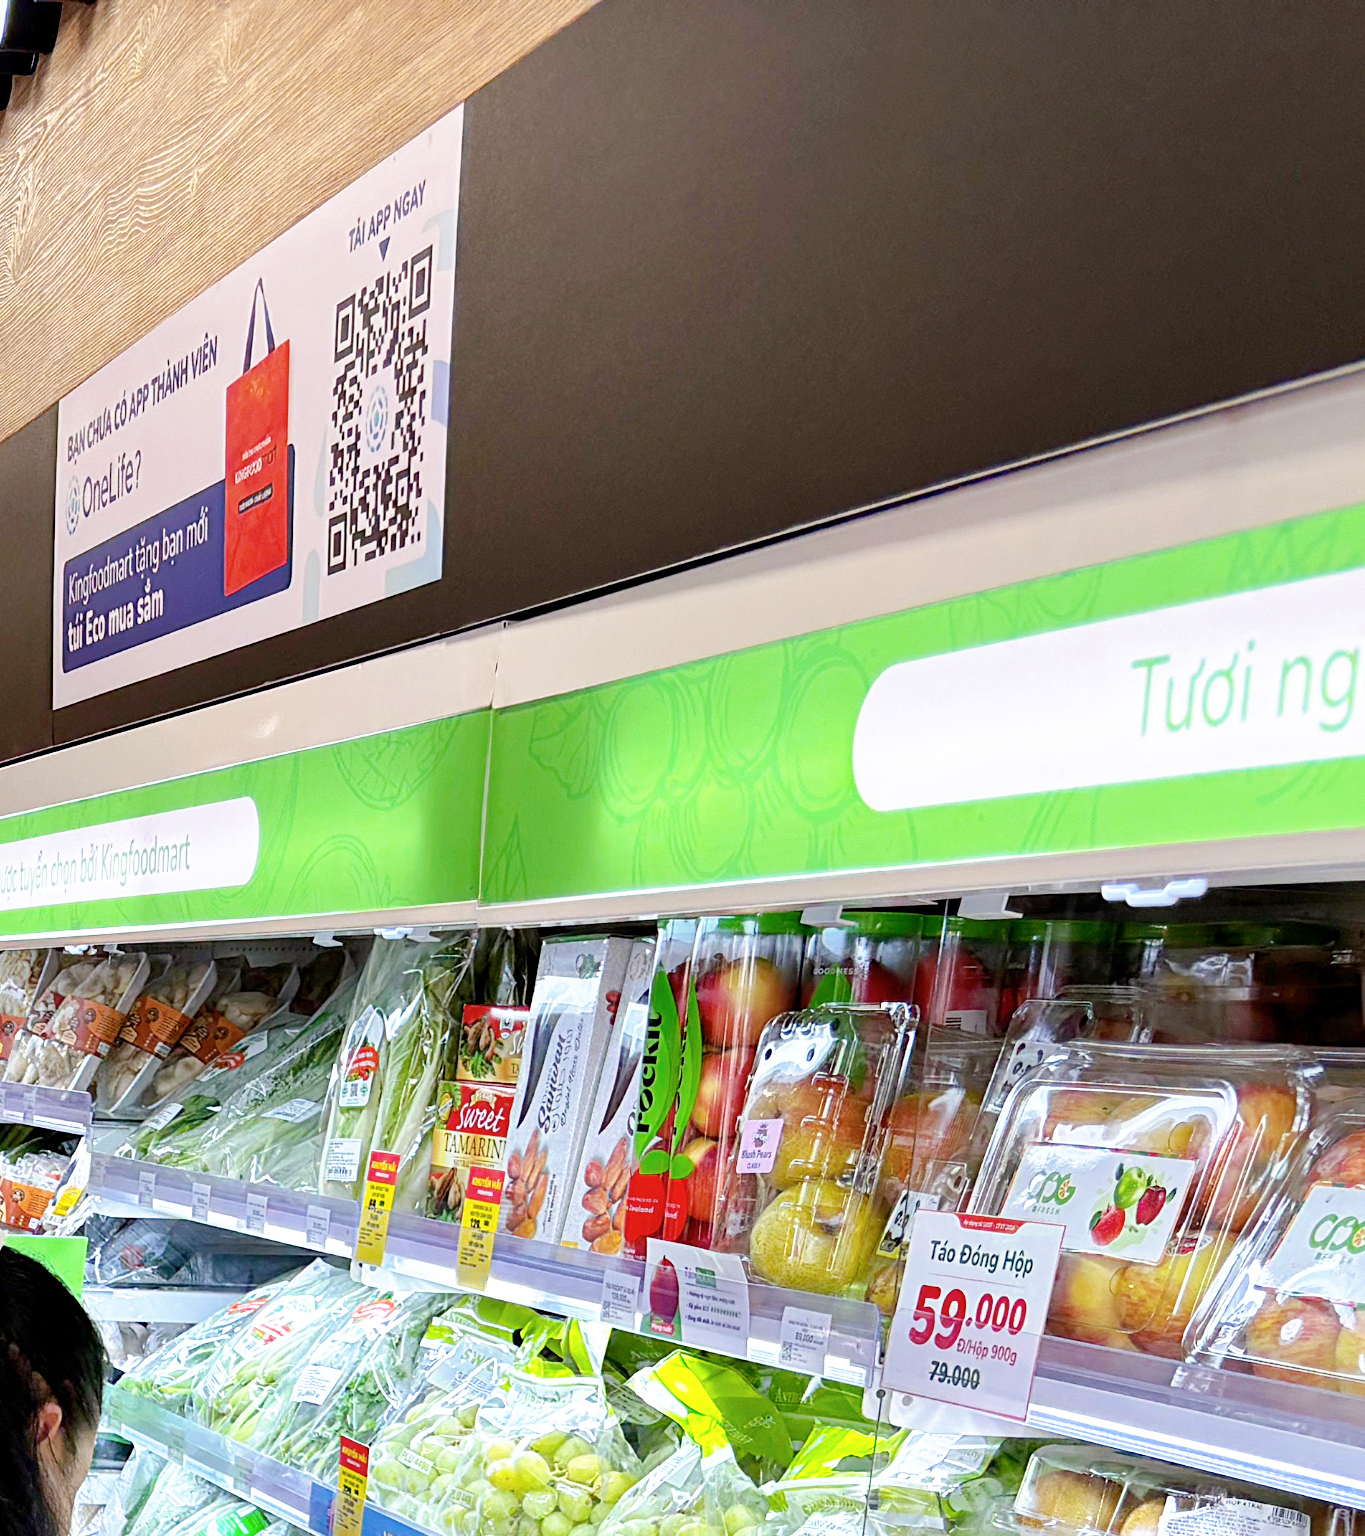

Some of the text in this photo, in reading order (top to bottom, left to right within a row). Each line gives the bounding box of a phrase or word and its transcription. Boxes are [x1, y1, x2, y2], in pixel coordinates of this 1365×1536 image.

[348, 180, 426, 254] TẢI APP NGAY
[66, 334, 218, 466] BẠN CHƯA CÓ APP THÀNH VIÊN
[82, 449, 142, 519] OneLife?
[68, 505, 209, 606] Kingfoodmart tặng bạn mới
[67, 578, 164, 654] túi Eco mua sắm
[20, 850, 47, 897] tuyển
[51, 852, 76, 894] chọn
[81, 843, 98, 883] bởi
[101, 834, 190, 888] Kingfoodmart
[456, 1103, 505, 1132] Sweet
[930, 1240, 1034, 1277] Táo Đóng Hộp
[909, 1284, 1027, 1349] 59.000
[929, 1360, 980, 1390] 79.000
[957, 1337, 1017, 1365] Đ/Hộp 900g
